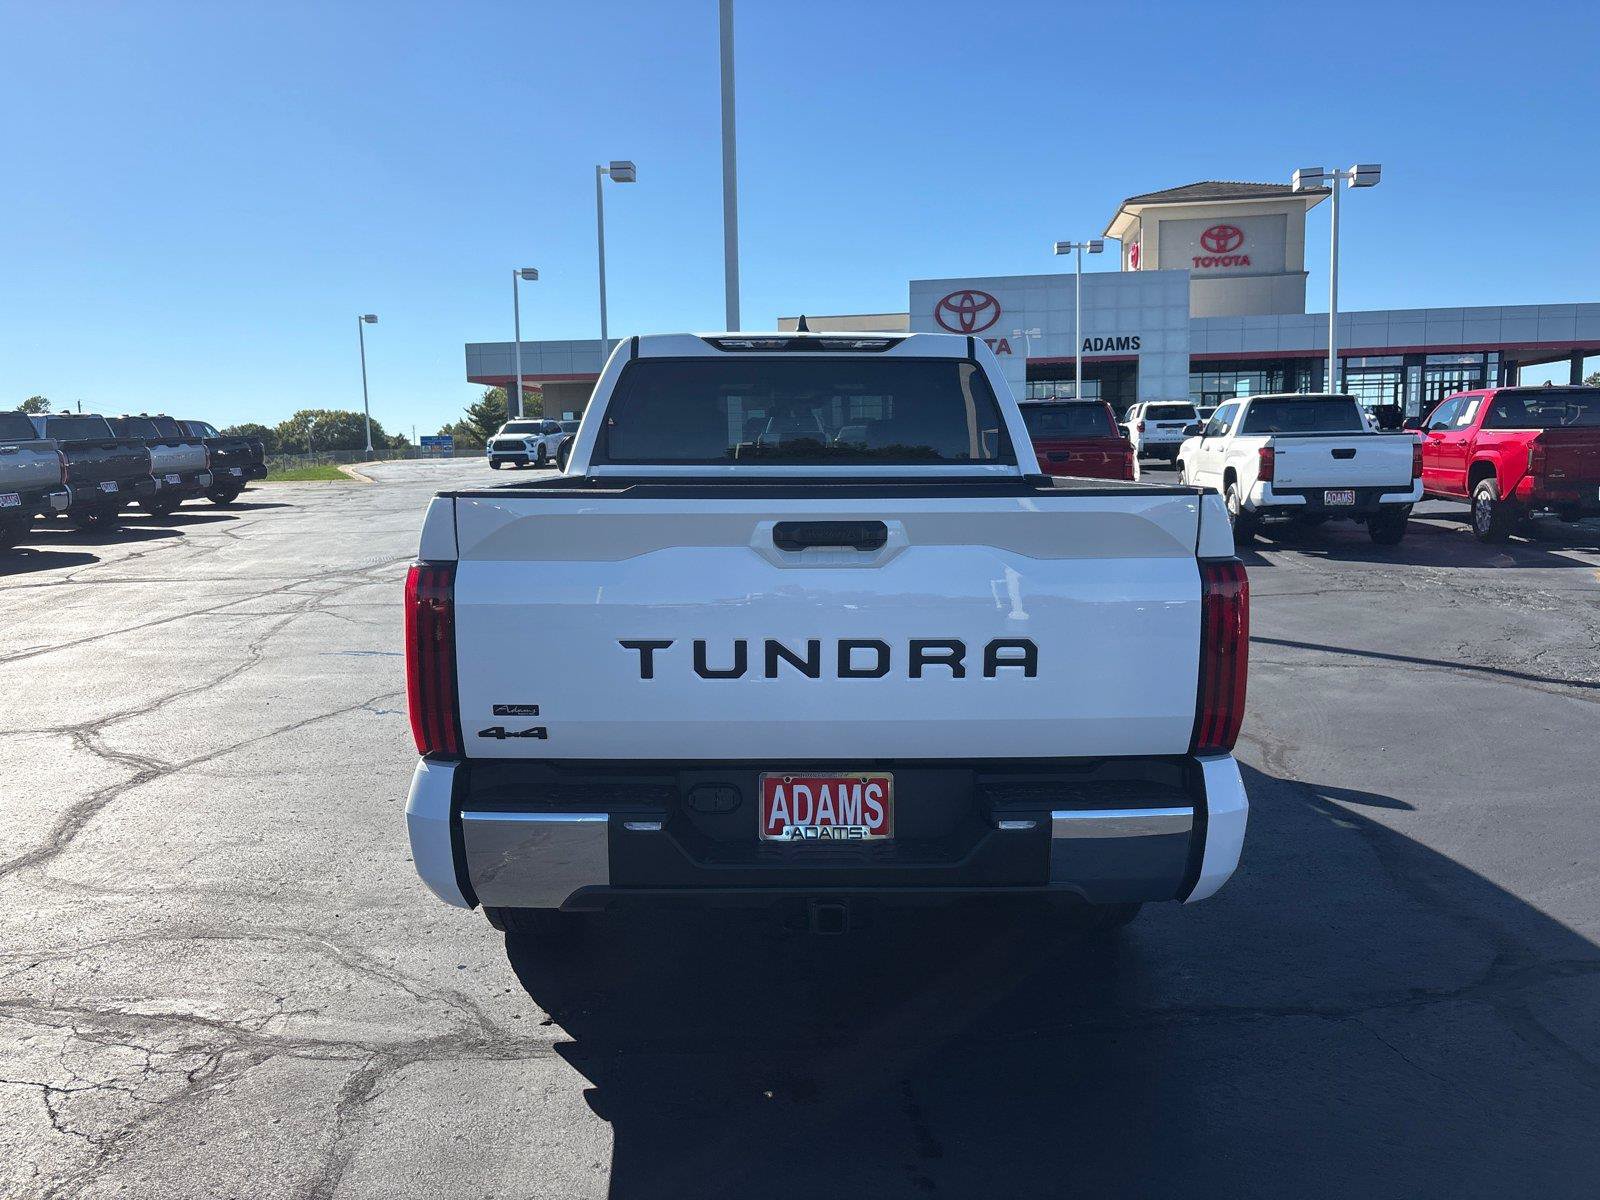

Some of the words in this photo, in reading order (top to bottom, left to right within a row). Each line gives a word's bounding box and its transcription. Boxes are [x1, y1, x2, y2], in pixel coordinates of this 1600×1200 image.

[1192, 255, 1250, 268] TOYOTA
[1082, 336, 1141, 352] ADAMS
[1326, 492, 1353, 503] ADAMS
[618, 638, 1039, 680] TUNDRA
[495, 705, 537, 714] Adams
[768, 783, 884, 829] ADAMS
[790, 826, 863, 840] ADAMS
